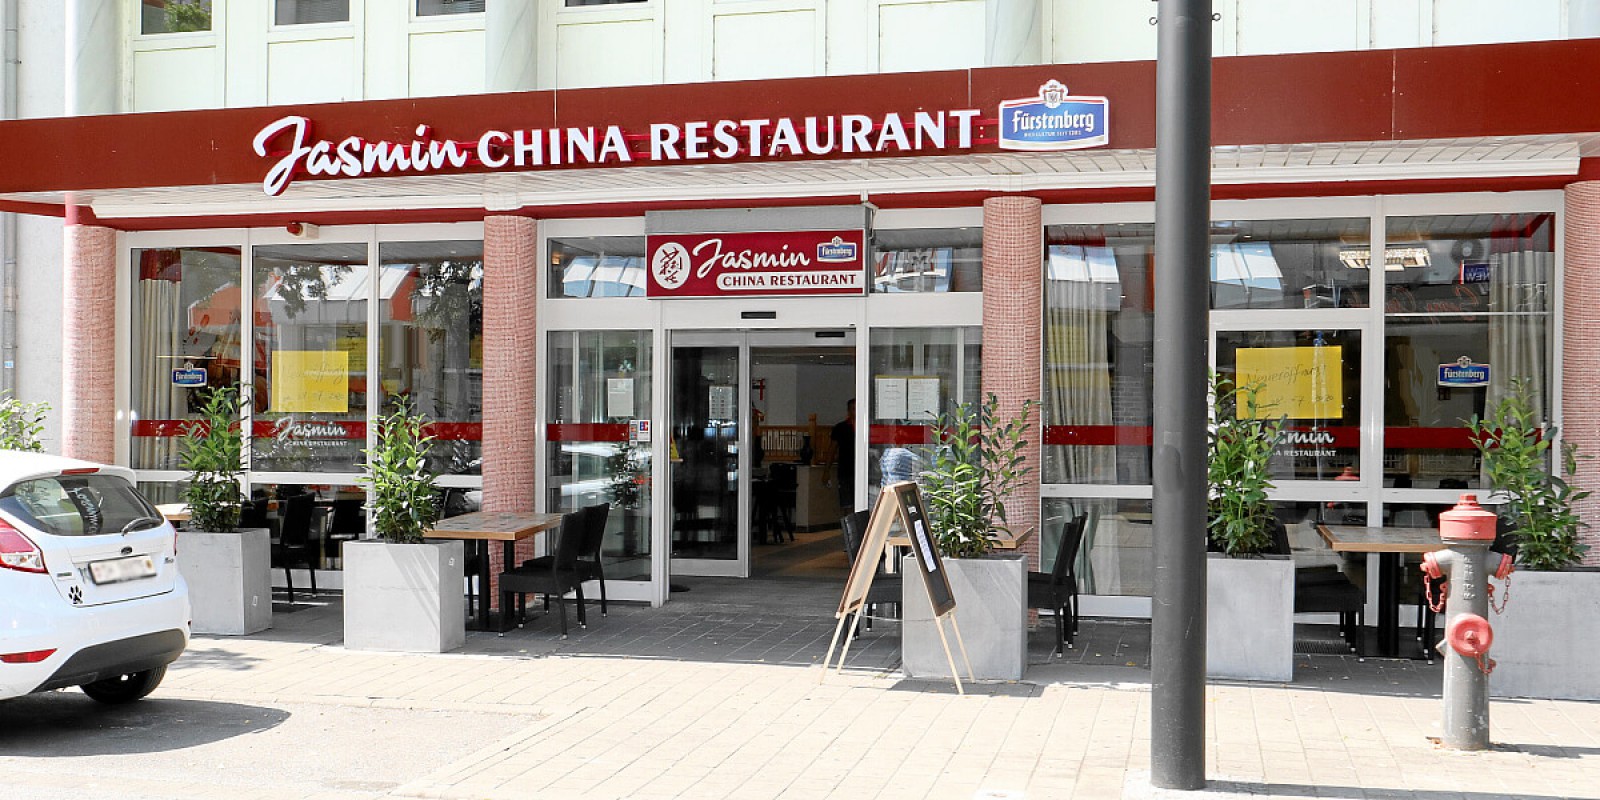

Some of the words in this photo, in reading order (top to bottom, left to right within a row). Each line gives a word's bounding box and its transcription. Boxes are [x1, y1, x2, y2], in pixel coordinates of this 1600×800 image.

[1012, 110, 1094, 133] Fürstenberg
[253, 115, 467, 197] Jasmin
[477, 125, 632, 168] CHINA
[650, 109, 981, 161] RESTAURANT
[692, 238, 810, 279] Jasmin
[723, 275, 765, 287] CHINA
[770, 274, 857, 286] RESTAURANT
[275, 415, 346, 441] Jasmin
